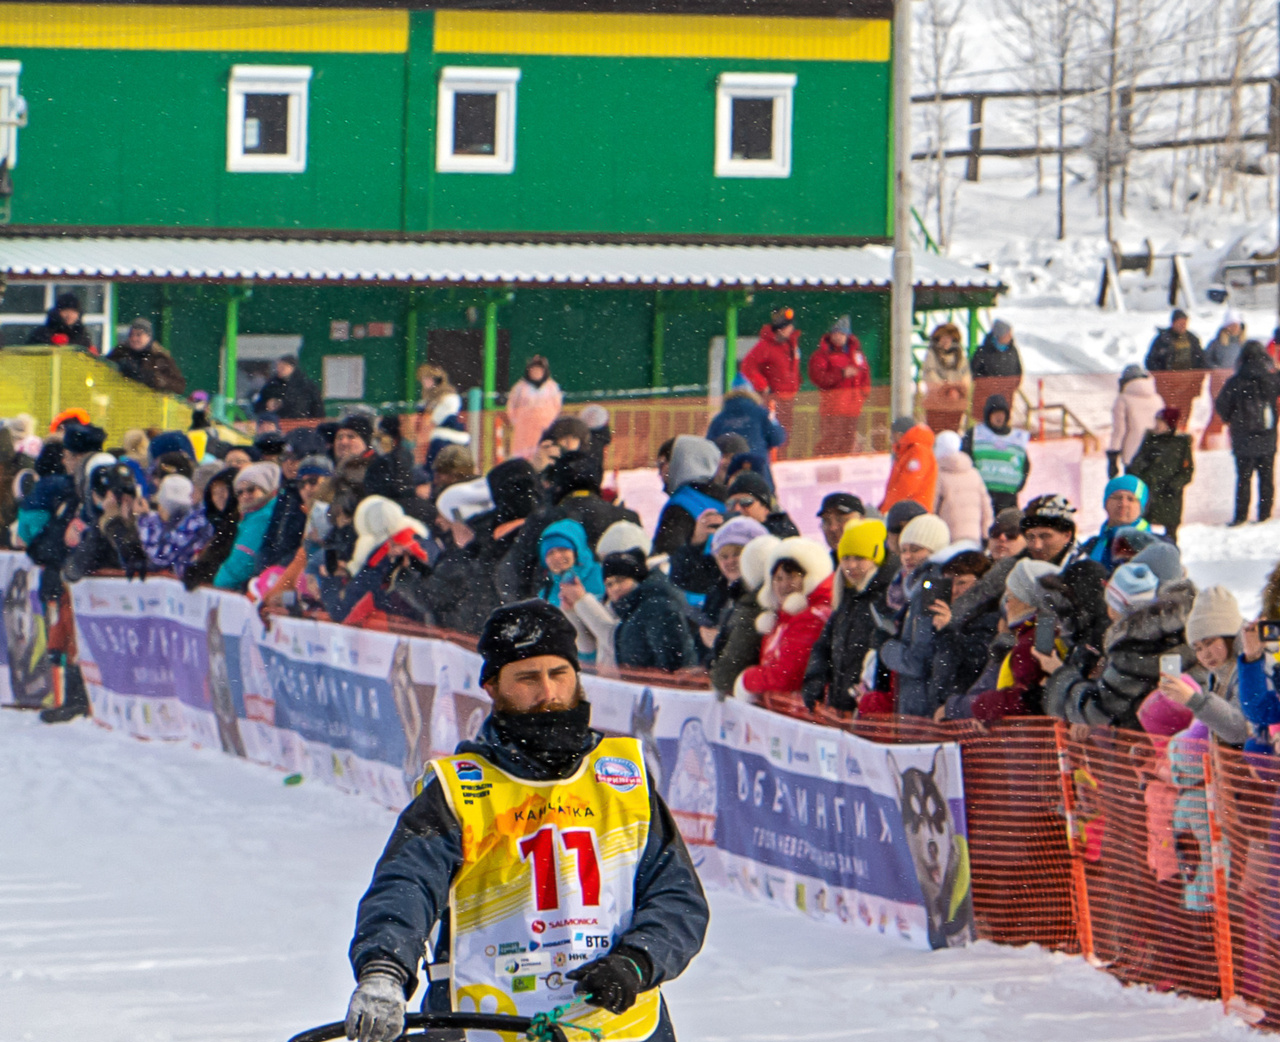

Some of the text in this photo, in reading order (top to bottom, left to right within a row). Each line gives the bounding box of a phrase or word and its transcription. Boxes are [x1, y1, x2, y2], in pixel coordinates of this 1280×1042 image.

[519, 827, 601, 912] 11
[548, 918, 599, 929] SALMONICA
[585, 935, 610, 949] ВТБ
